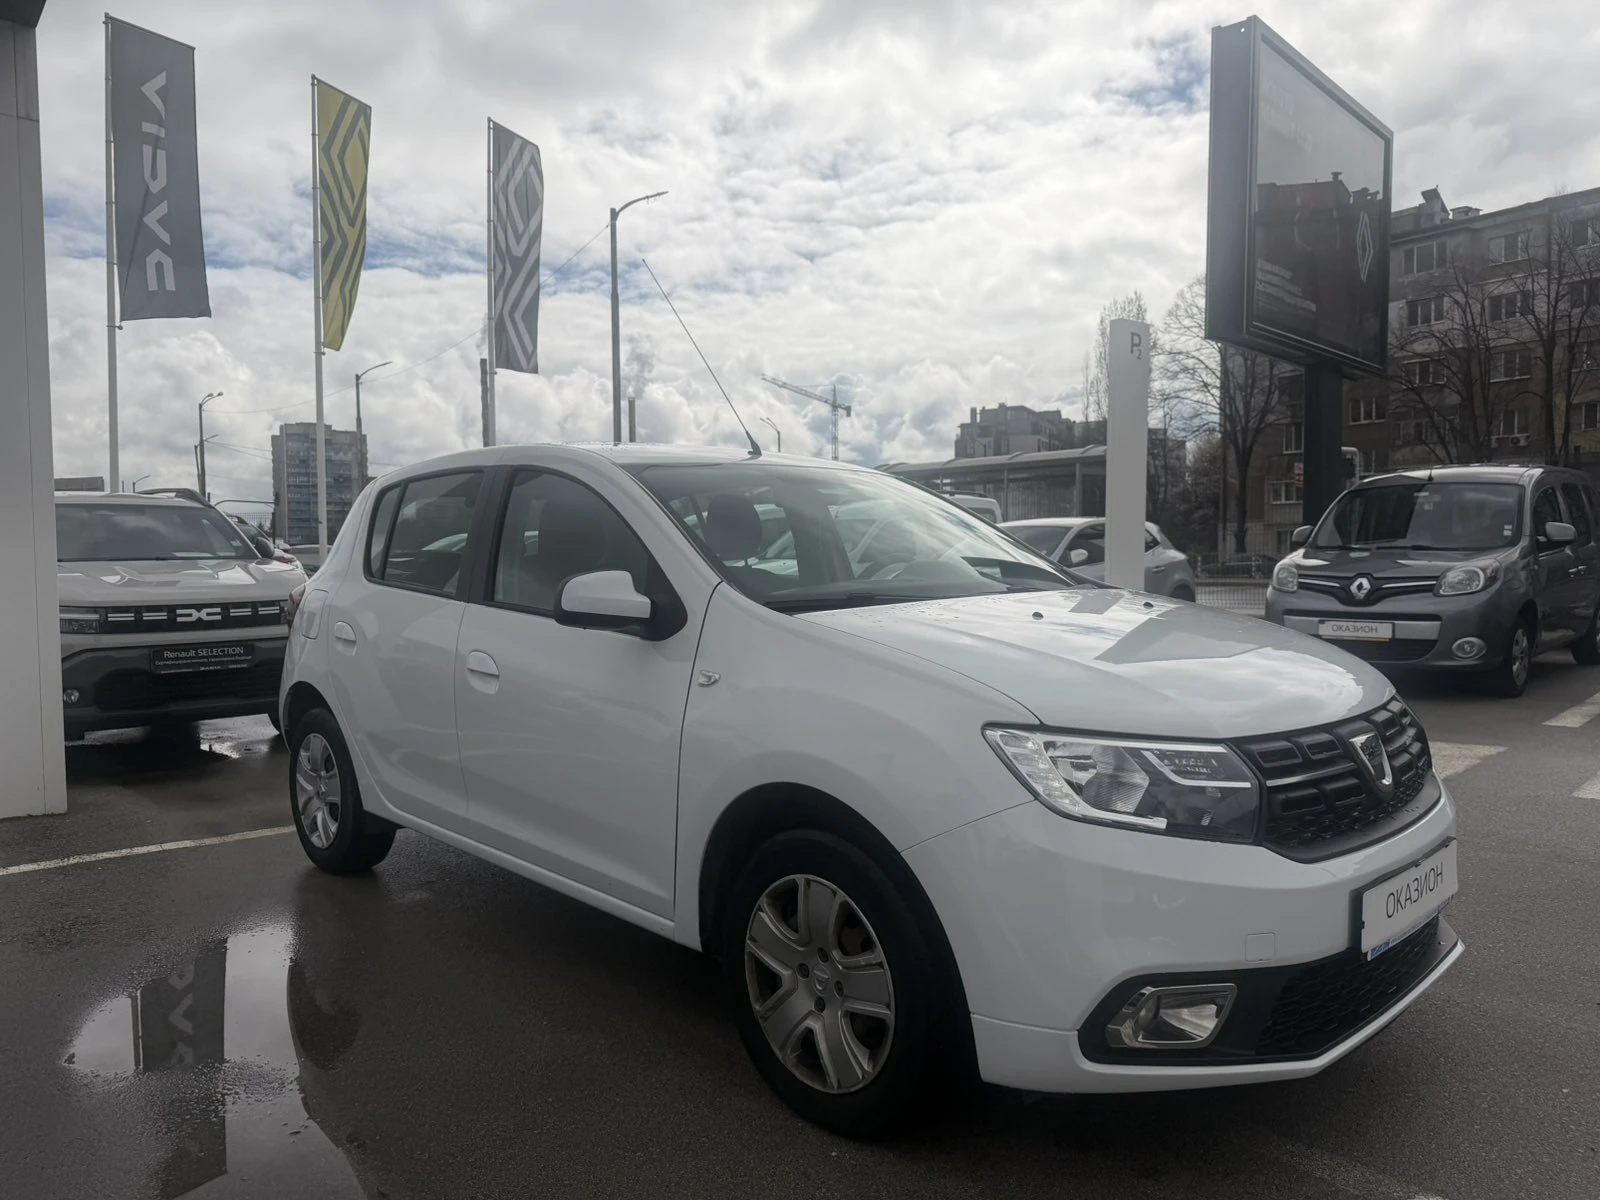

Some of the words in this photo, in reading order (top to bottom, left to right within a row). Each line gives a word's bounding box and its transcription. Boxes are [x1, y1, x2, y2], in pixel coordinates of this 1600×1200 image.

[140, 70, 176, 292] DACIA
[1331, 624, 1378, 633] ОКАЗИОН
[163, 649, 196, 659] Renault
[197, 647, 244, 657] SELECTION
[1385, 861, 1444, 919] ОКАЗИОН
